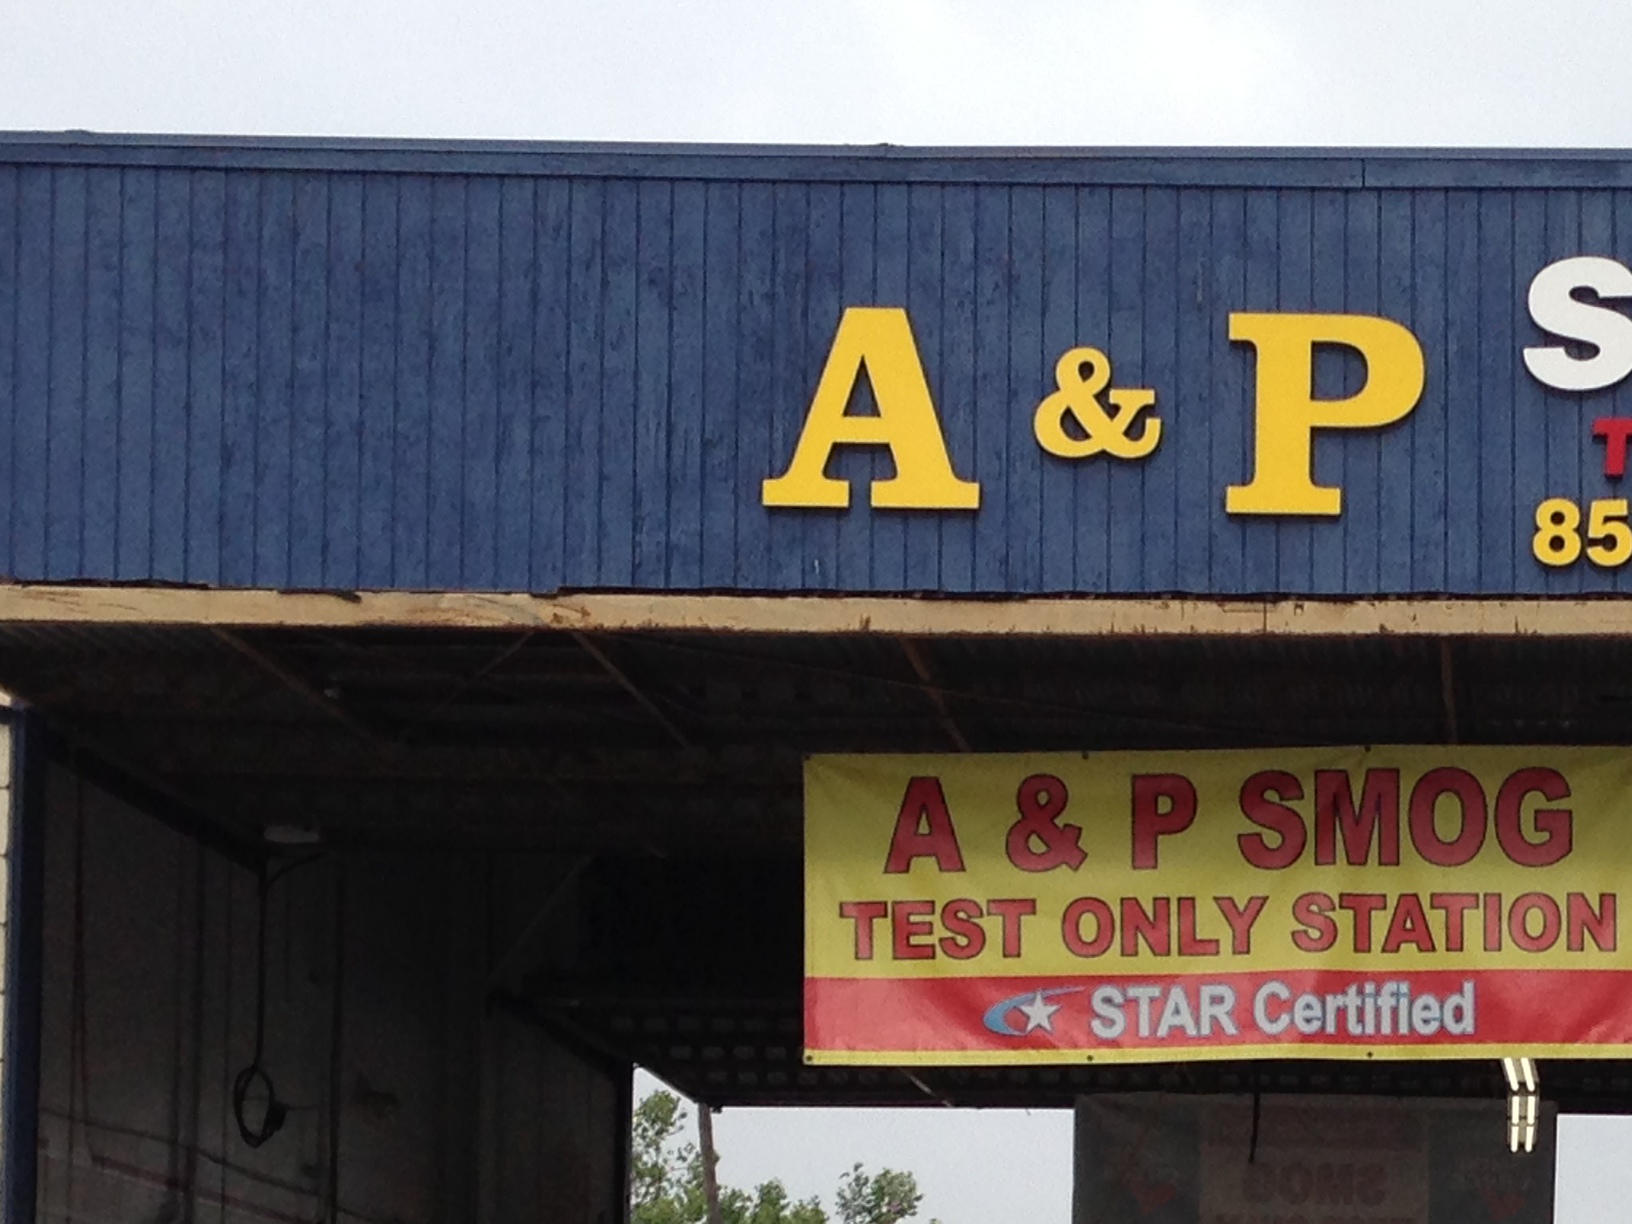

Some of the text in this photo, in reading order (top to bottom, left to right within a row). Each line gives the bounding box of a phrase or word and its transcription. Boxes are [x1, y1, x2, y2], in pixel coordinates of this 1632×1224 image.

[762, 307, 1425, 515] A & P
[884, 766, 1575, 874] A & P SMOG
[838, 892, 1618, 961] TEST ONLY STATION
[1090, 980, 1477, 1038] STAR Certified
